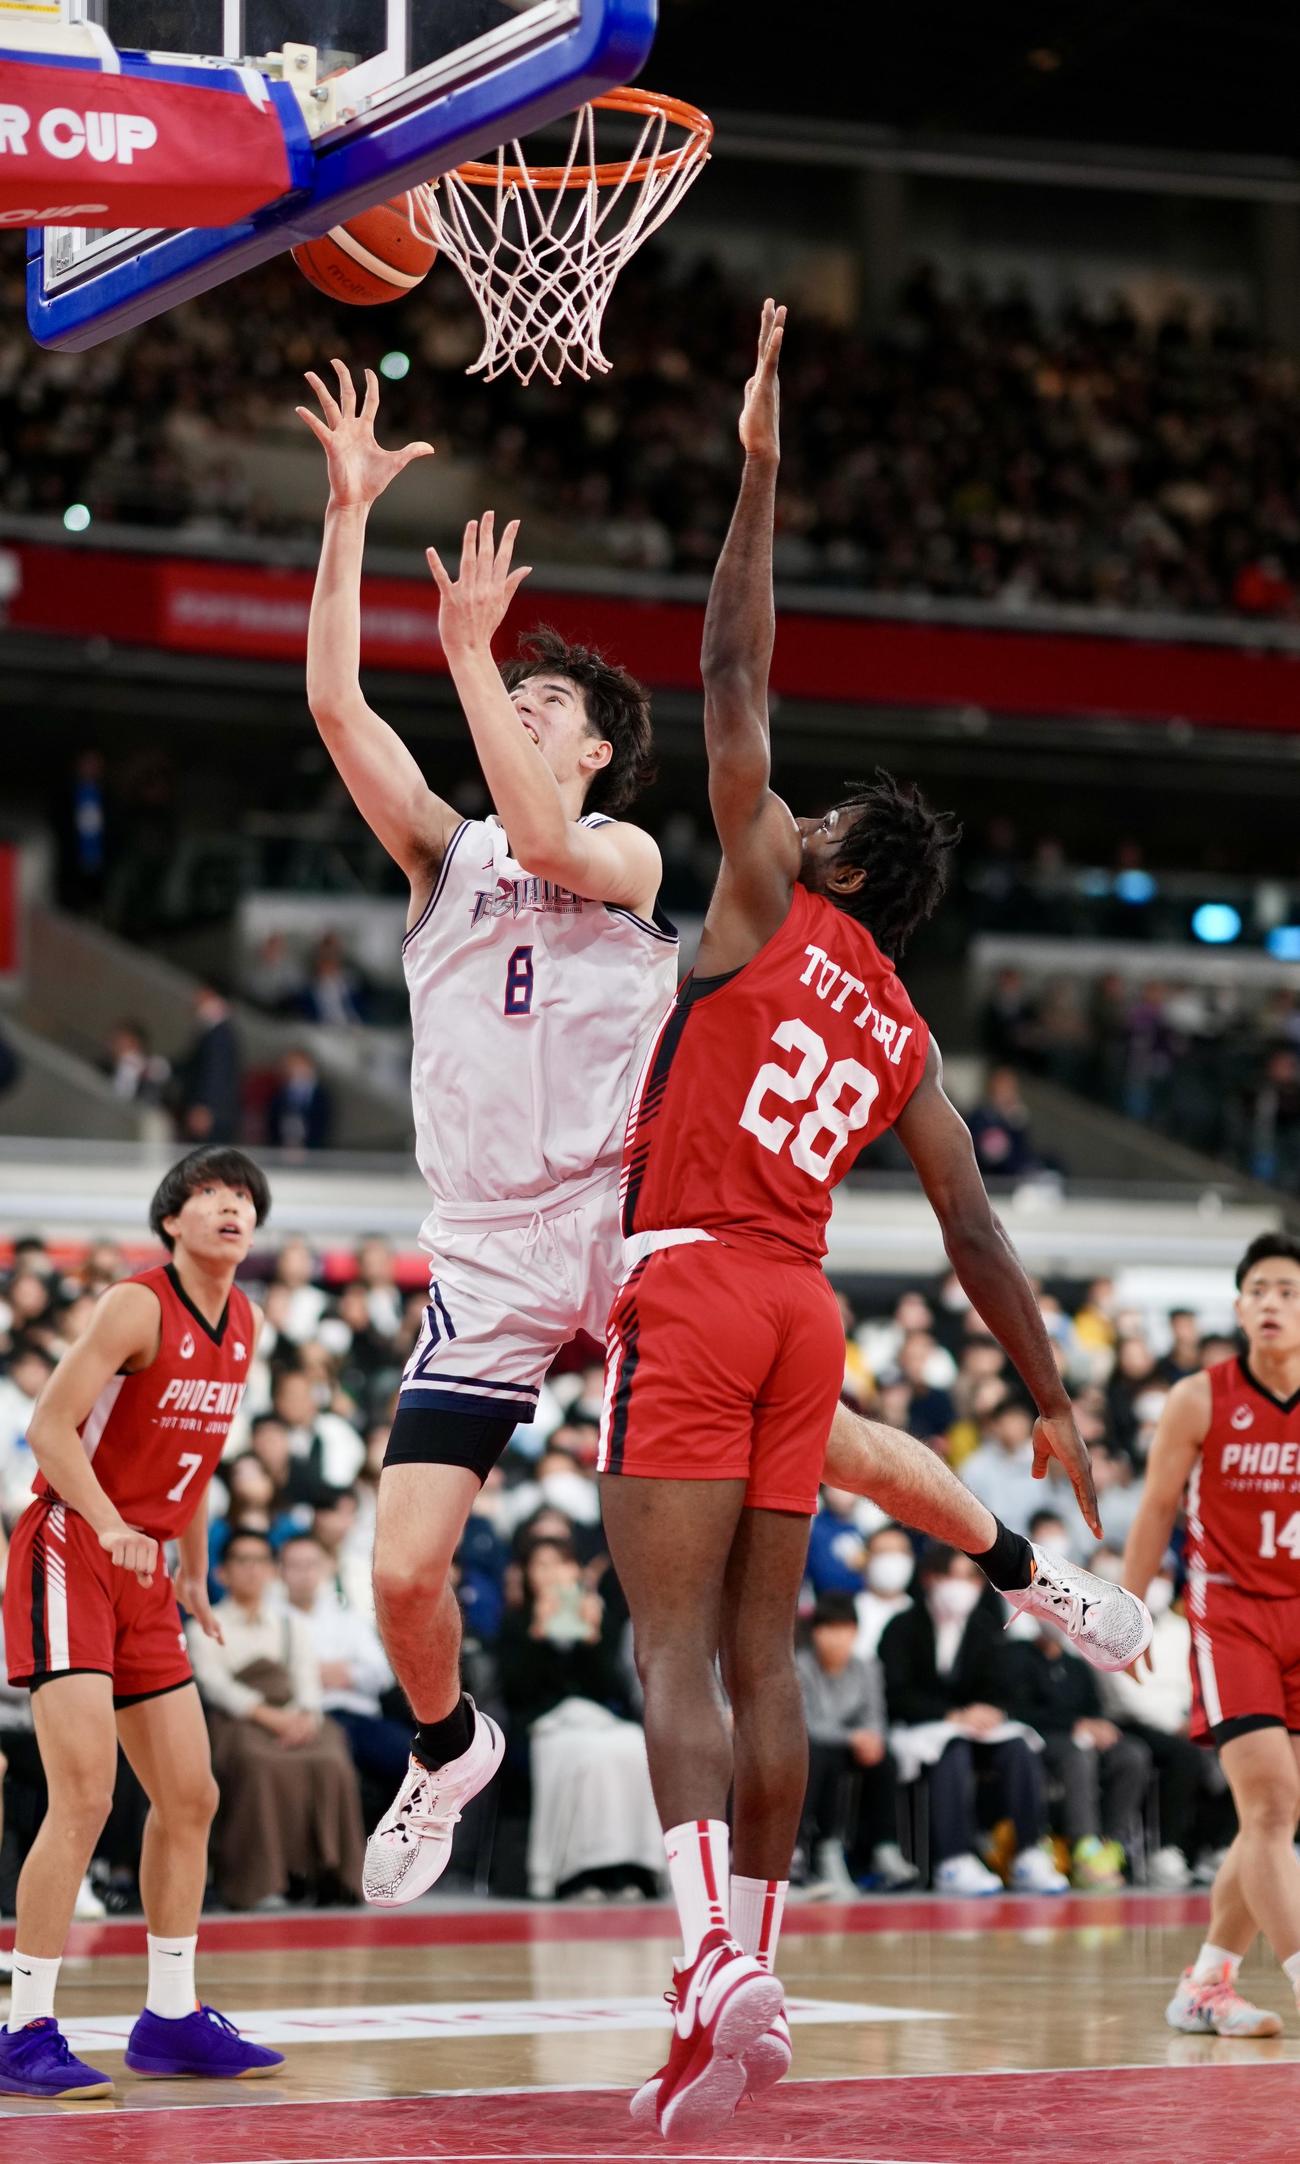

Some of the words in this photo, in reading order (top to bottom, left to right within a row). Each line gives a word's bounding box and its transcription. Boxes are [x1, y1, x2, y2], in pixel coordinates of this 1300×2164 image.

[38, 107, 158, 165] CUP
[504, 944, 534, 1016] 8
[738, 1018, 880, 1182] 28
[166, 1452, 203, 1502] 7
[1221, 1442, 1300, 1475] PHOE
[1258, 1510, 1300, 1560] 14
